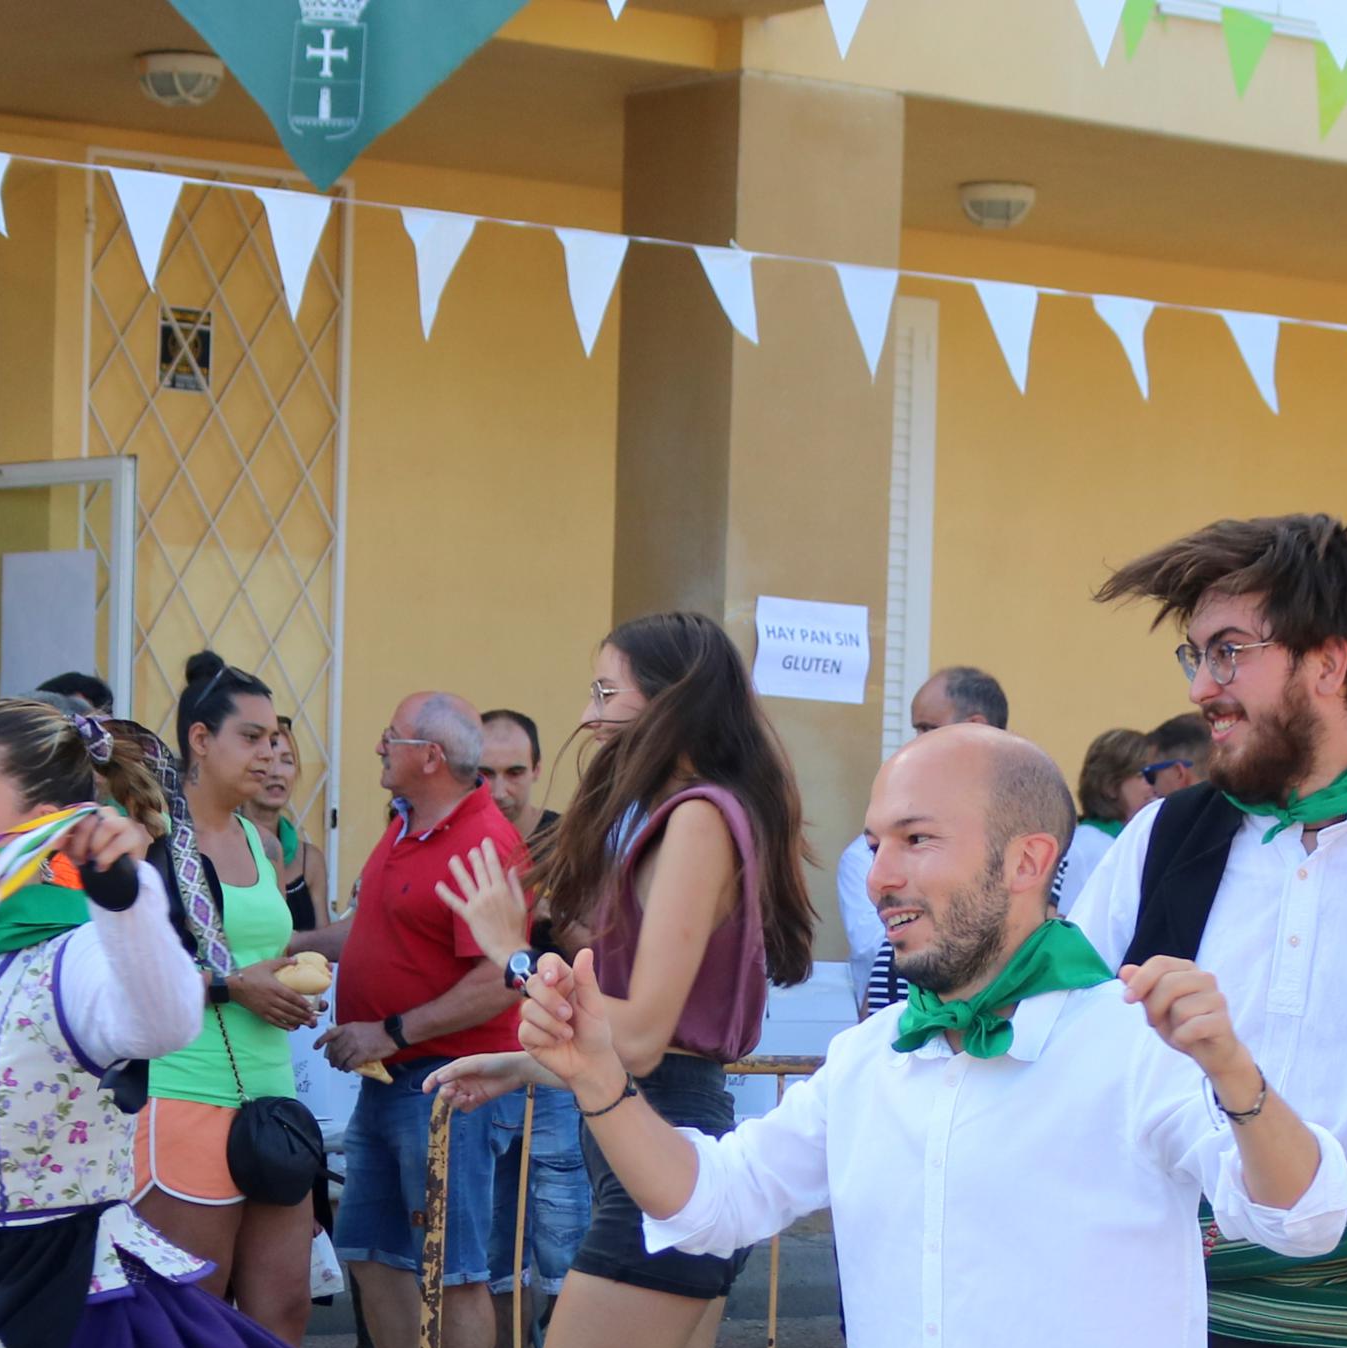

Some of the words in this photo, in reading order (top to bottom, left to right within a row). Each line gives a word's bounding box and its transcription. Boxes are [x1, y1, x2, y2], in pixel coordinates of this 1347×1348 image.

[765, 625, 796, 641] HAY
[800, 628, 832, 645] PAN
[835, 631, 861, 648] SIN
[781, 655, 843, 675] GLUTEN
